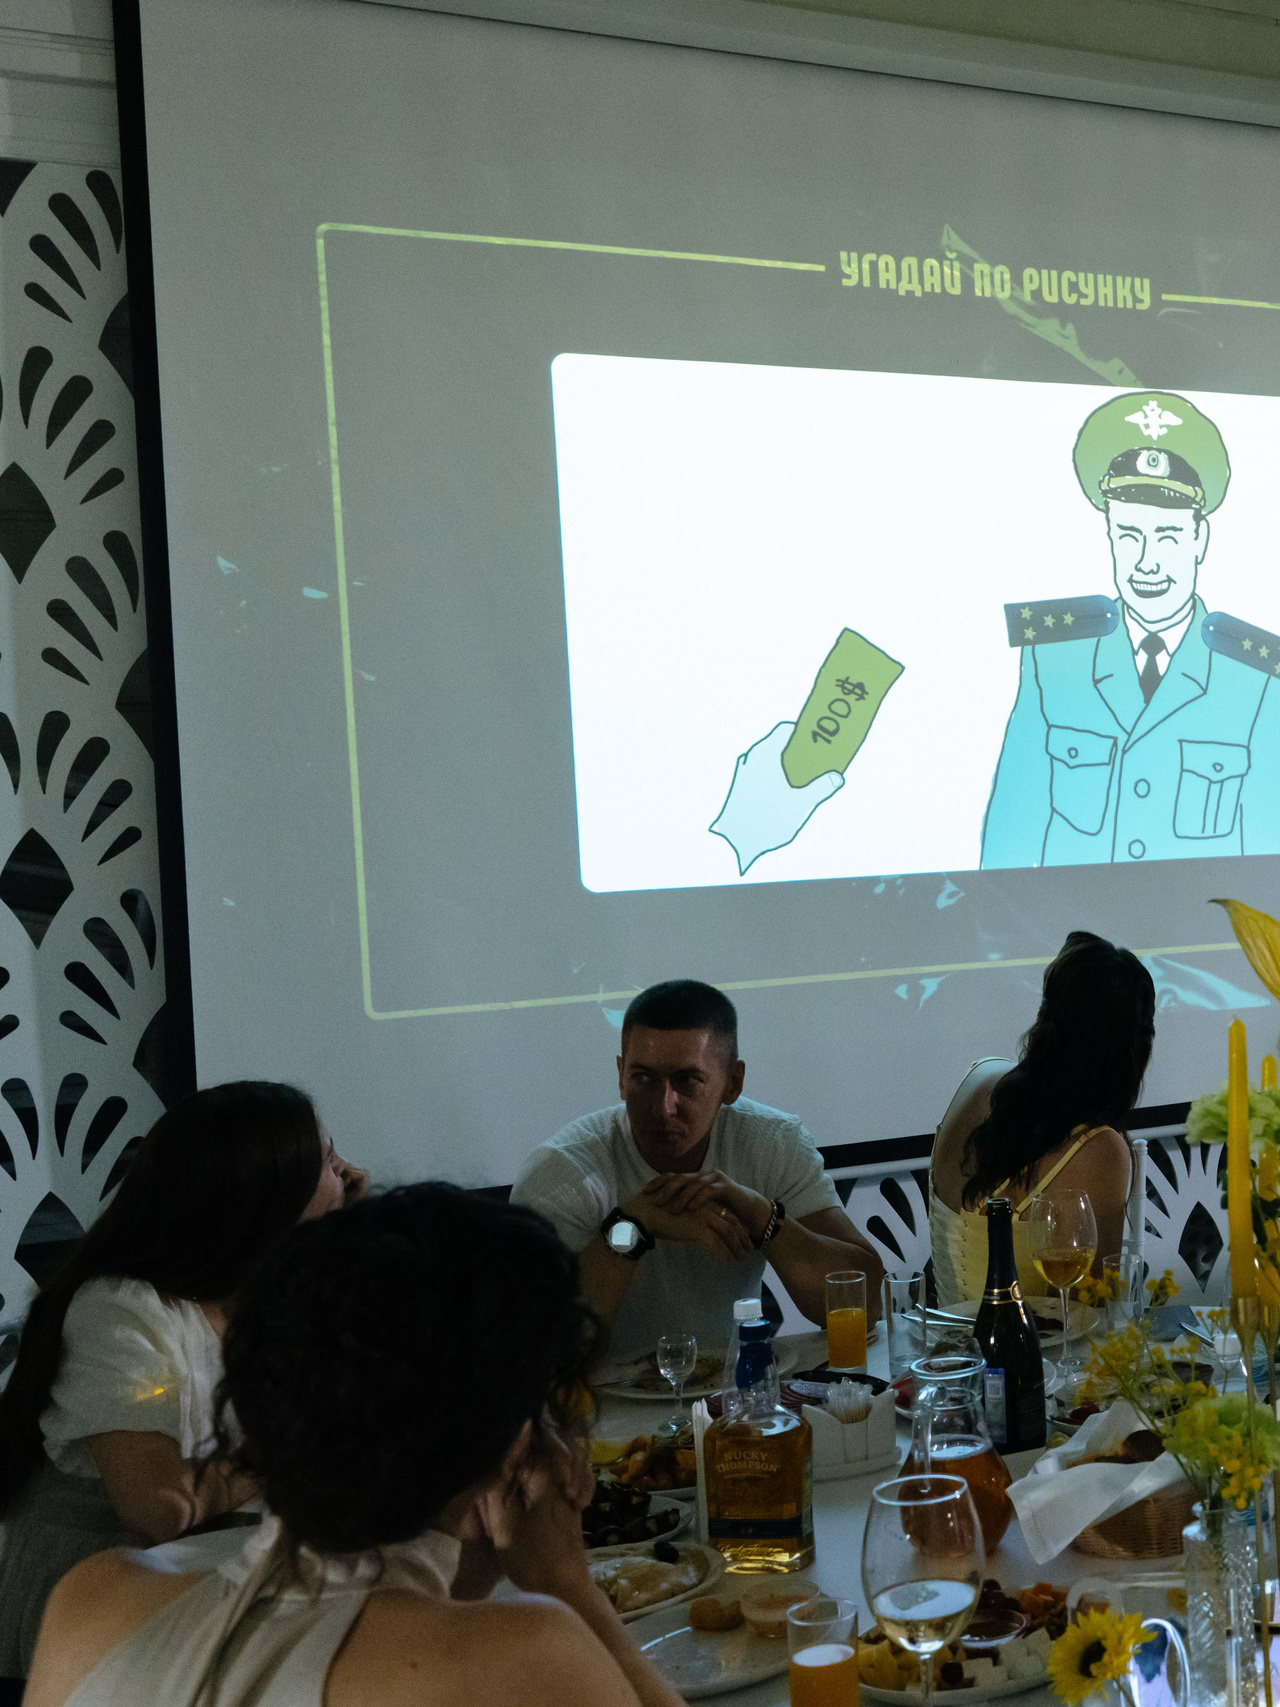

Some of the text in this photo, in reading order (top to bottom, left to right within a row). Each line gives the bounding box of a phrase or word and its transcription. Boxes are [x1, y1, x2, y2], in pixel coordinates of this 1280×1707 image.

[839, 250, 1151, 310] УГАДАЙ ПО РИСУНКУ
[811, 676, 869, 744] 100$
[715, 1460, 779, 1473] THOMPSON
